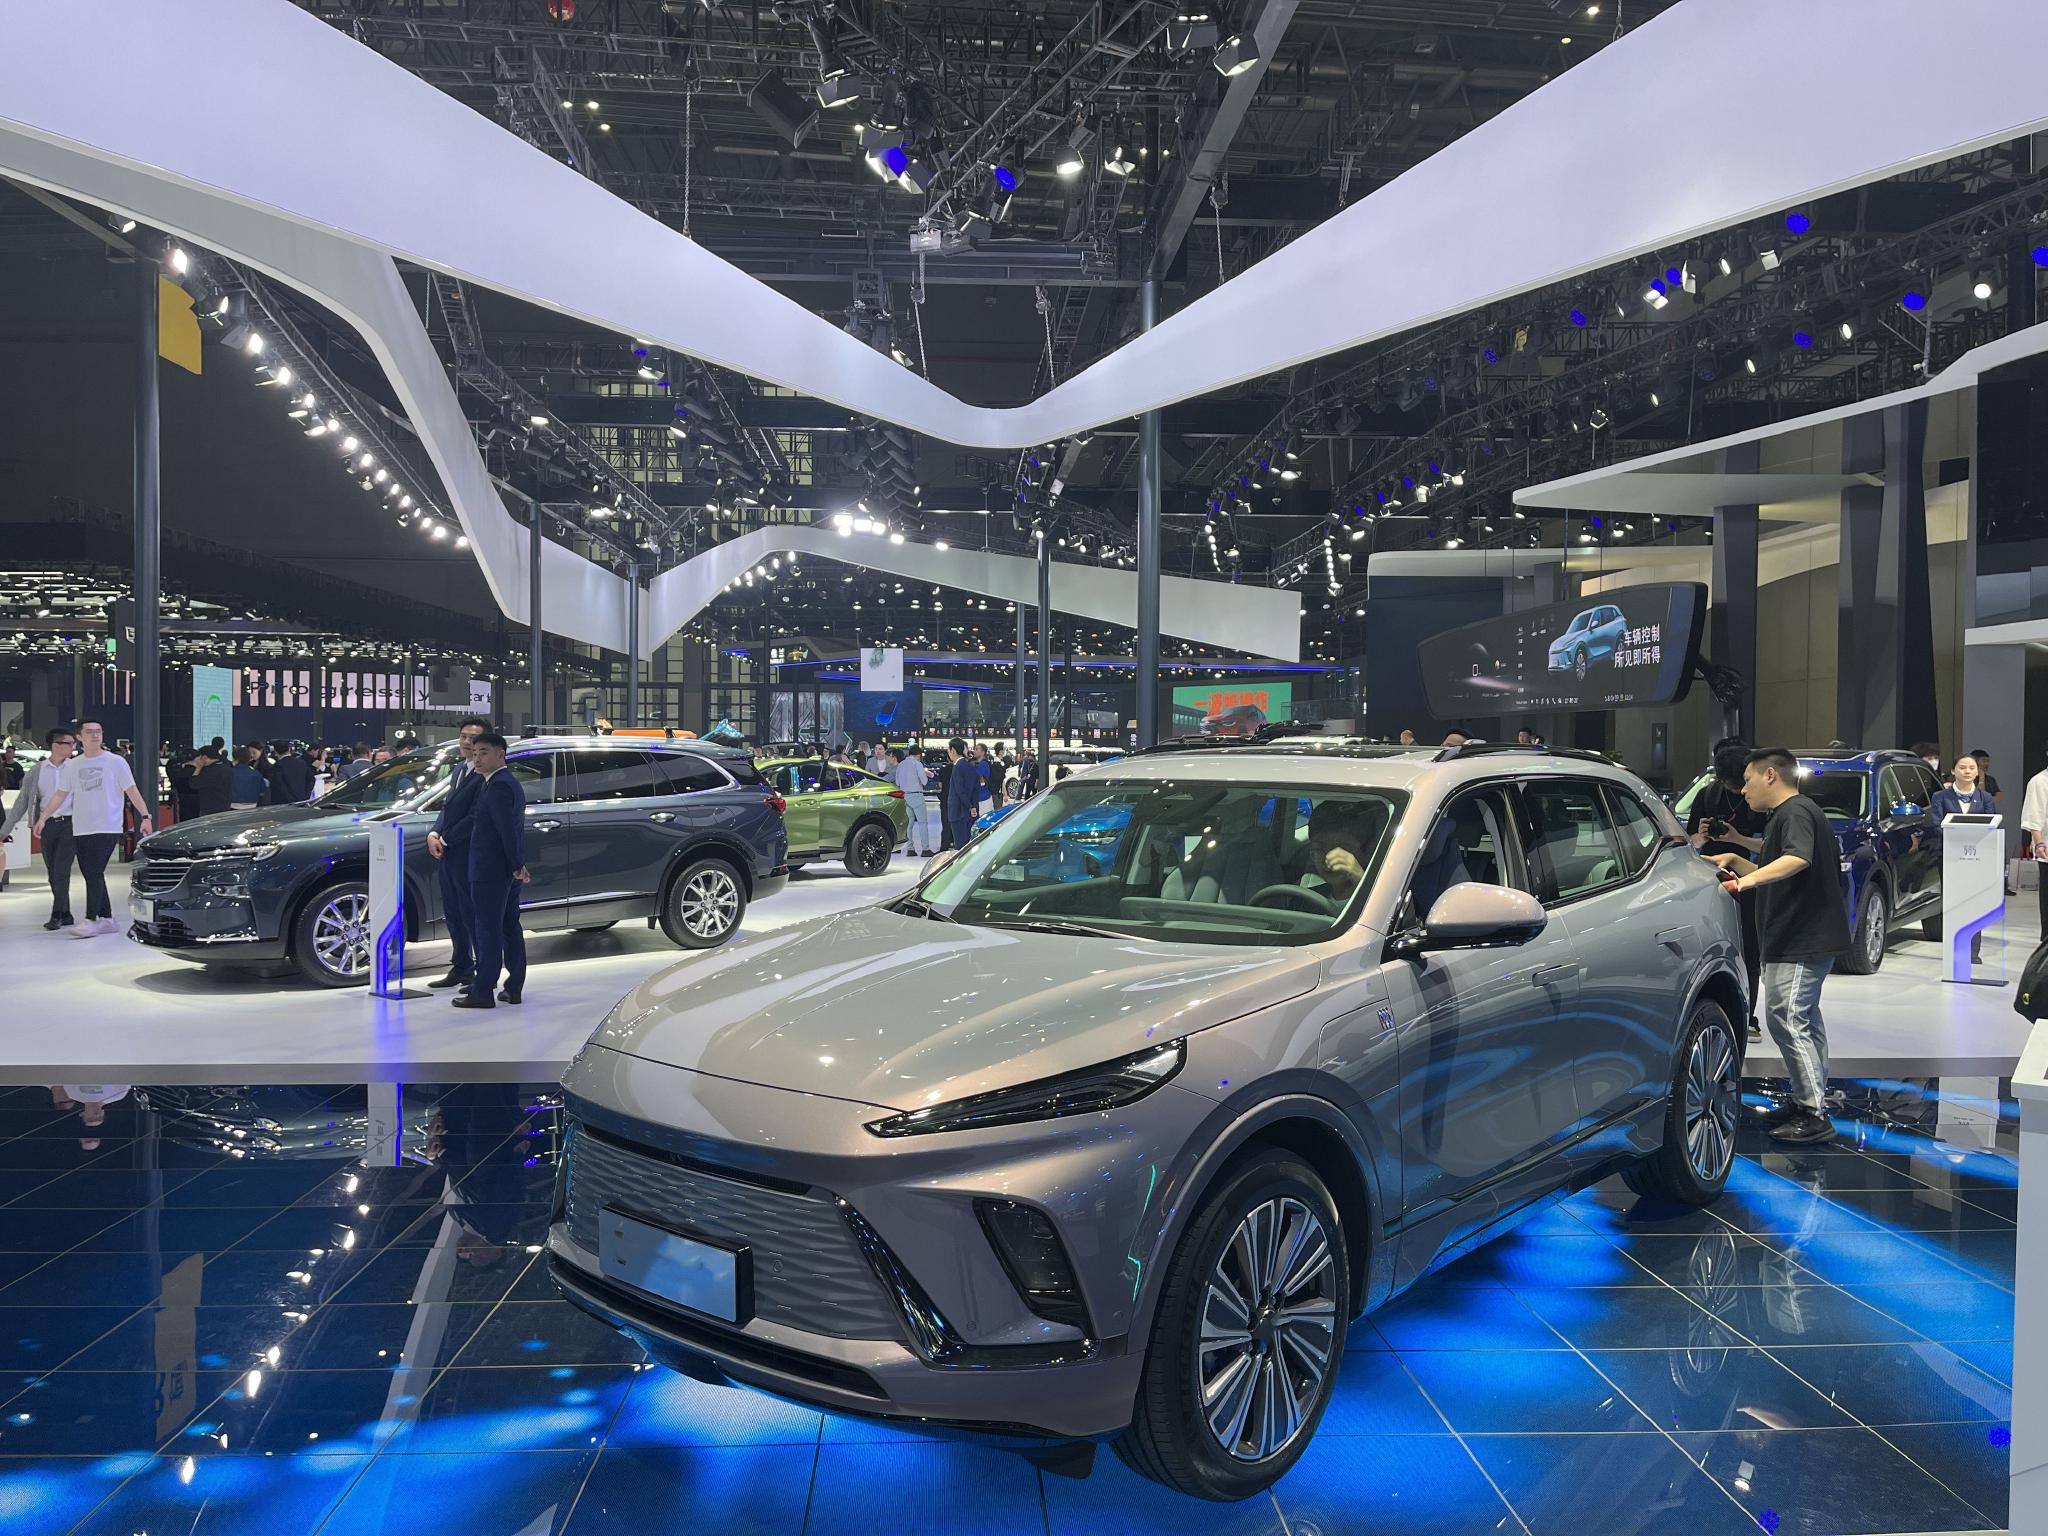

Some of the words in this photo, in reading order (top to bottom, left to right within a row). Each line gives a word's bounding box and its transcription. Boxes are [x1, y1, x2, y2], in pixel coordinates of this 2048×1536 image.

[1624, 623, 1660, 646] 车辆控制
[1614, 645, 1661, 668] 所见即所得
